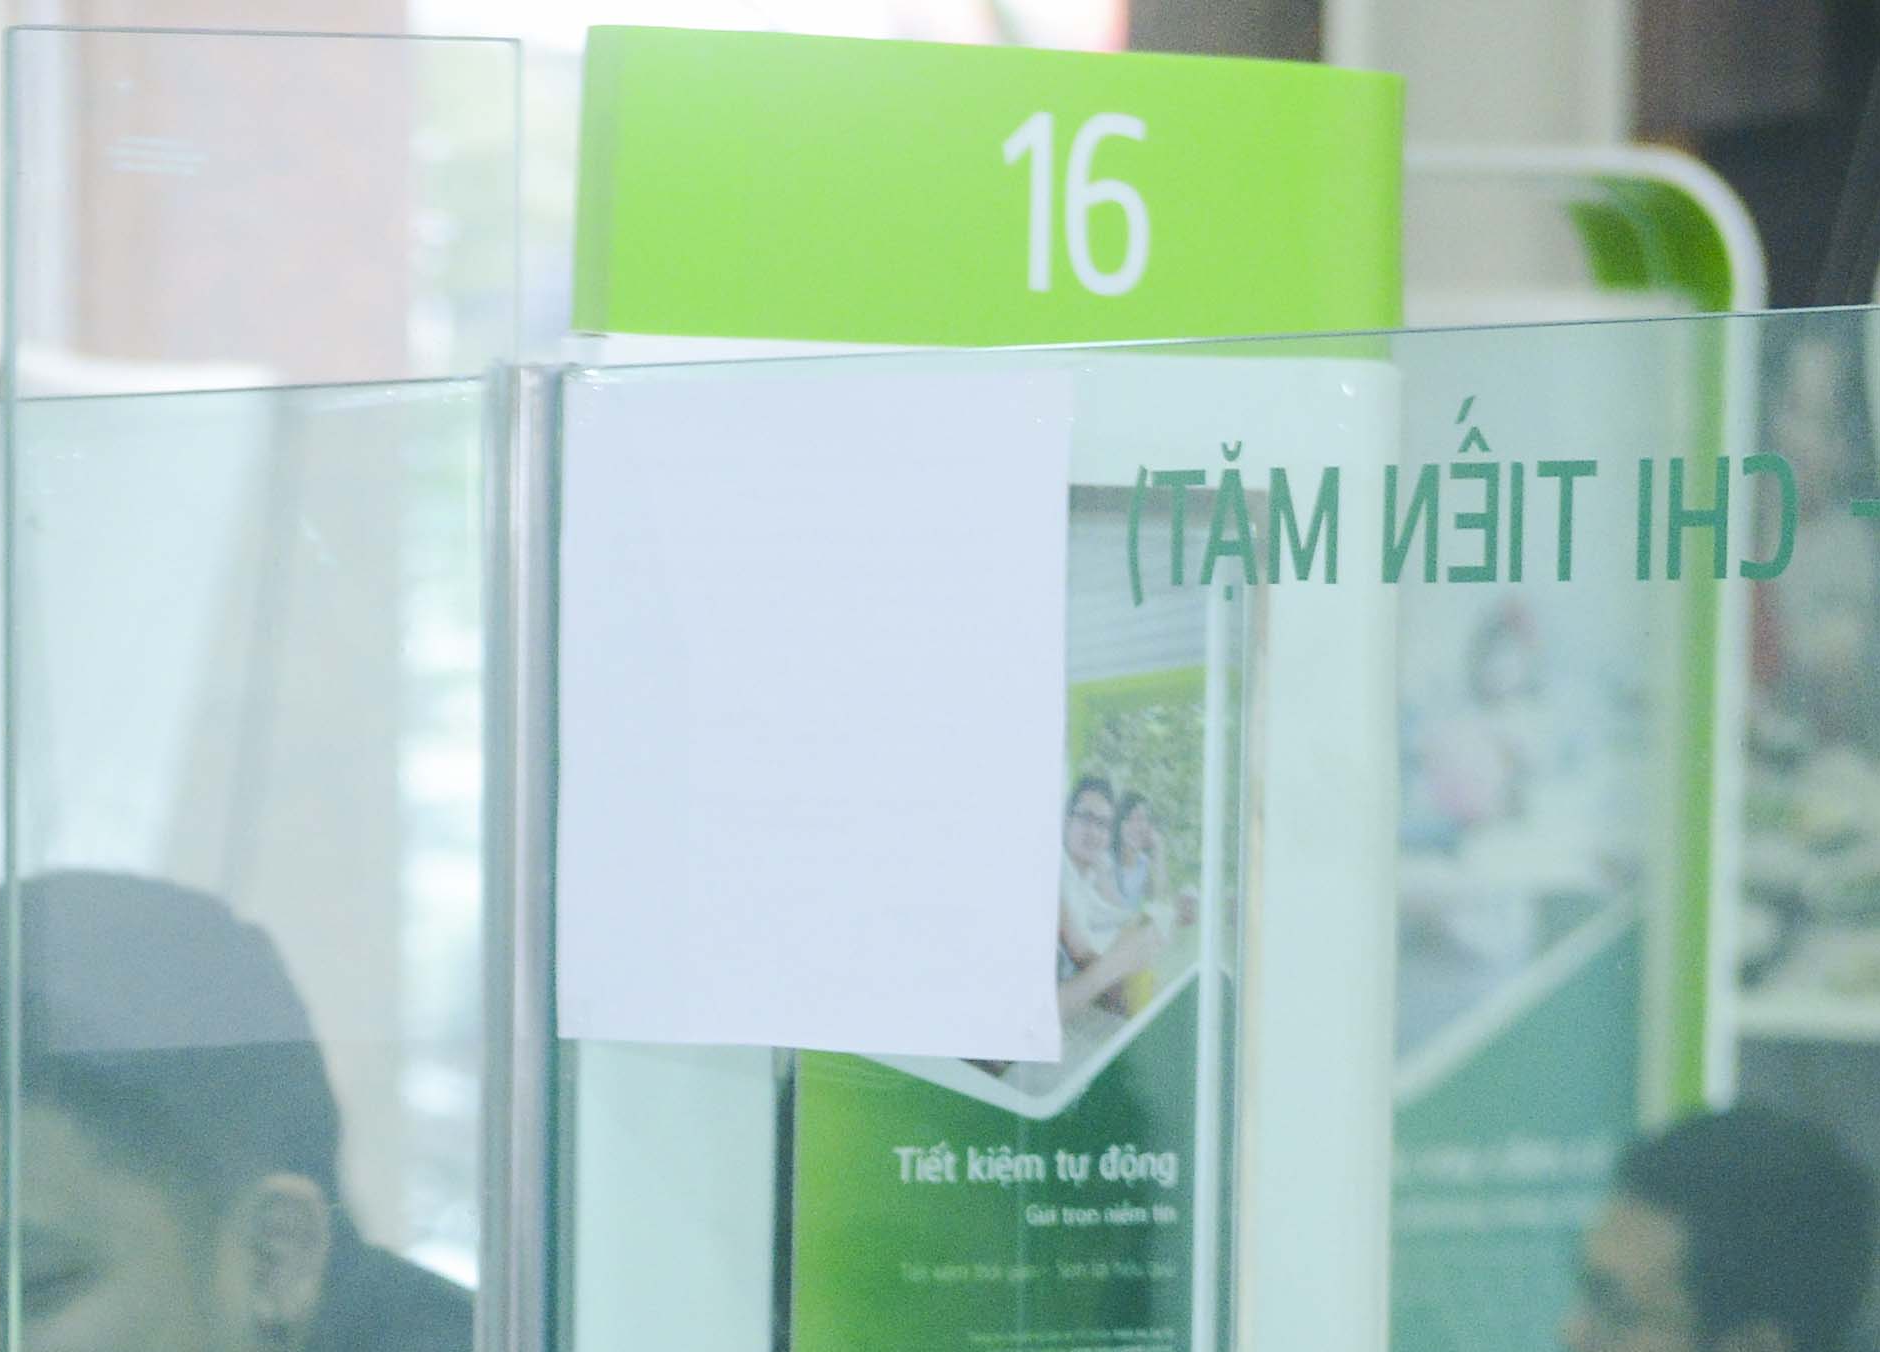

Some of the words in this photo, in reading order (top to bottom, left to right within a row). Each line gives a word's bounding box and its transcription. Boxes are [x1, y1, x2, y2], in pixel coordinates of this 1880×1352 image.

[1001, 110, 1152, 297] 16
[893, 1141, 958, 1184] Tiết
[967, 1145, 1046, 1189] kiệm
[1098, 1143, 1179, 1189] động
